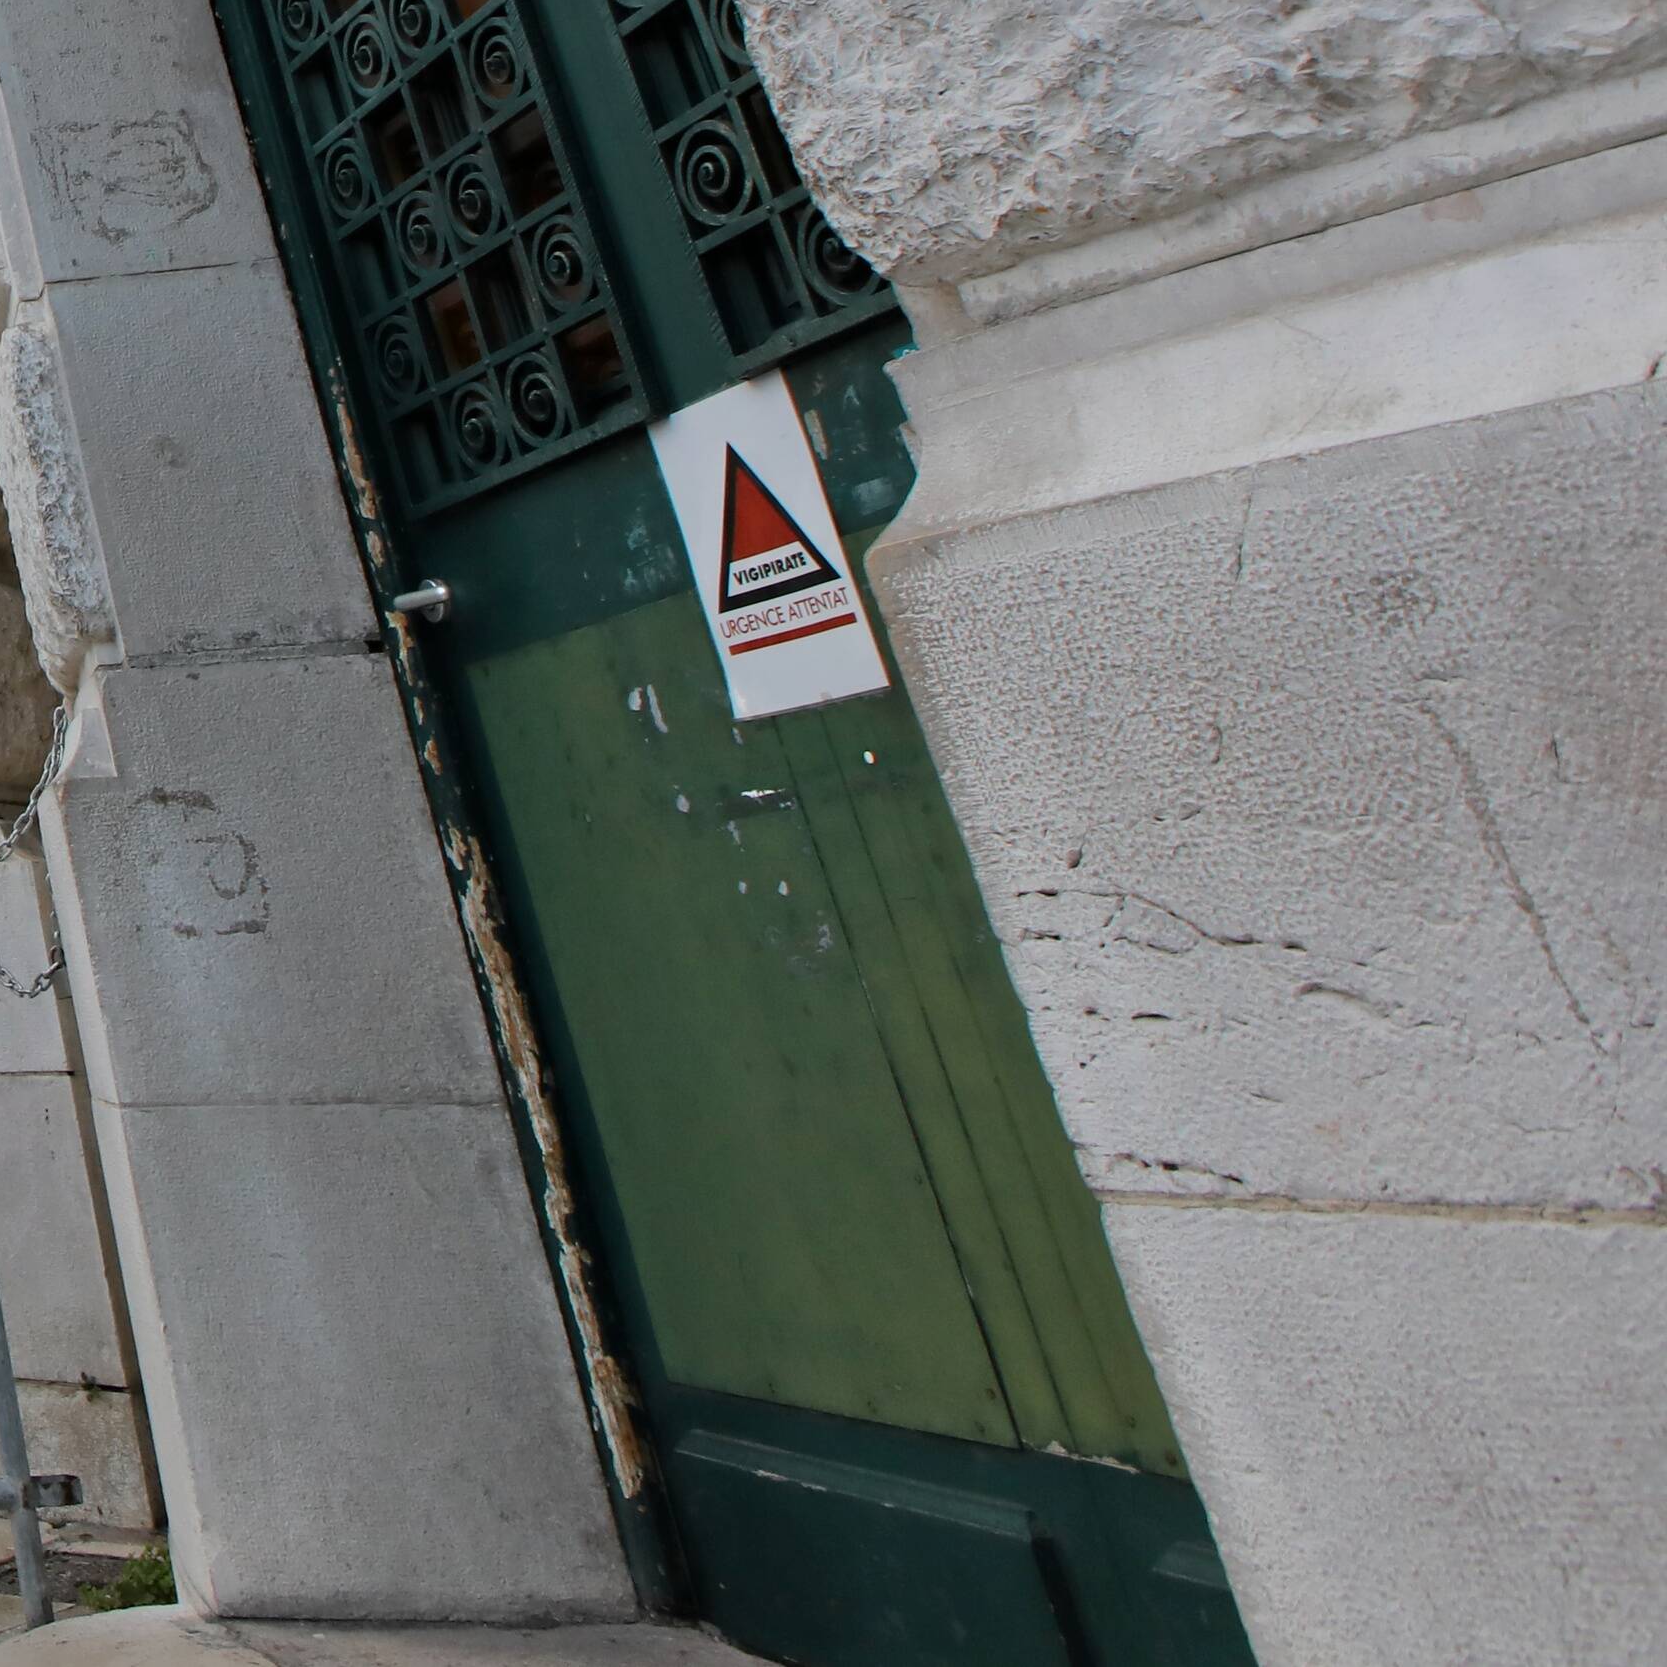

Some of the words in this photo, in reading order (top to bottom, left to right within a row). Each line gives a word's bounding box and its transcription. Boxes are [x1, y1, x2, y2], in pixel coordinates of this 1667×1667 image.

[733, 551, 807, 585] VIGIPIRATE
[720, 606, 786, 638] URGENCE
[789, 587, 848, 622] ATTENTAT
